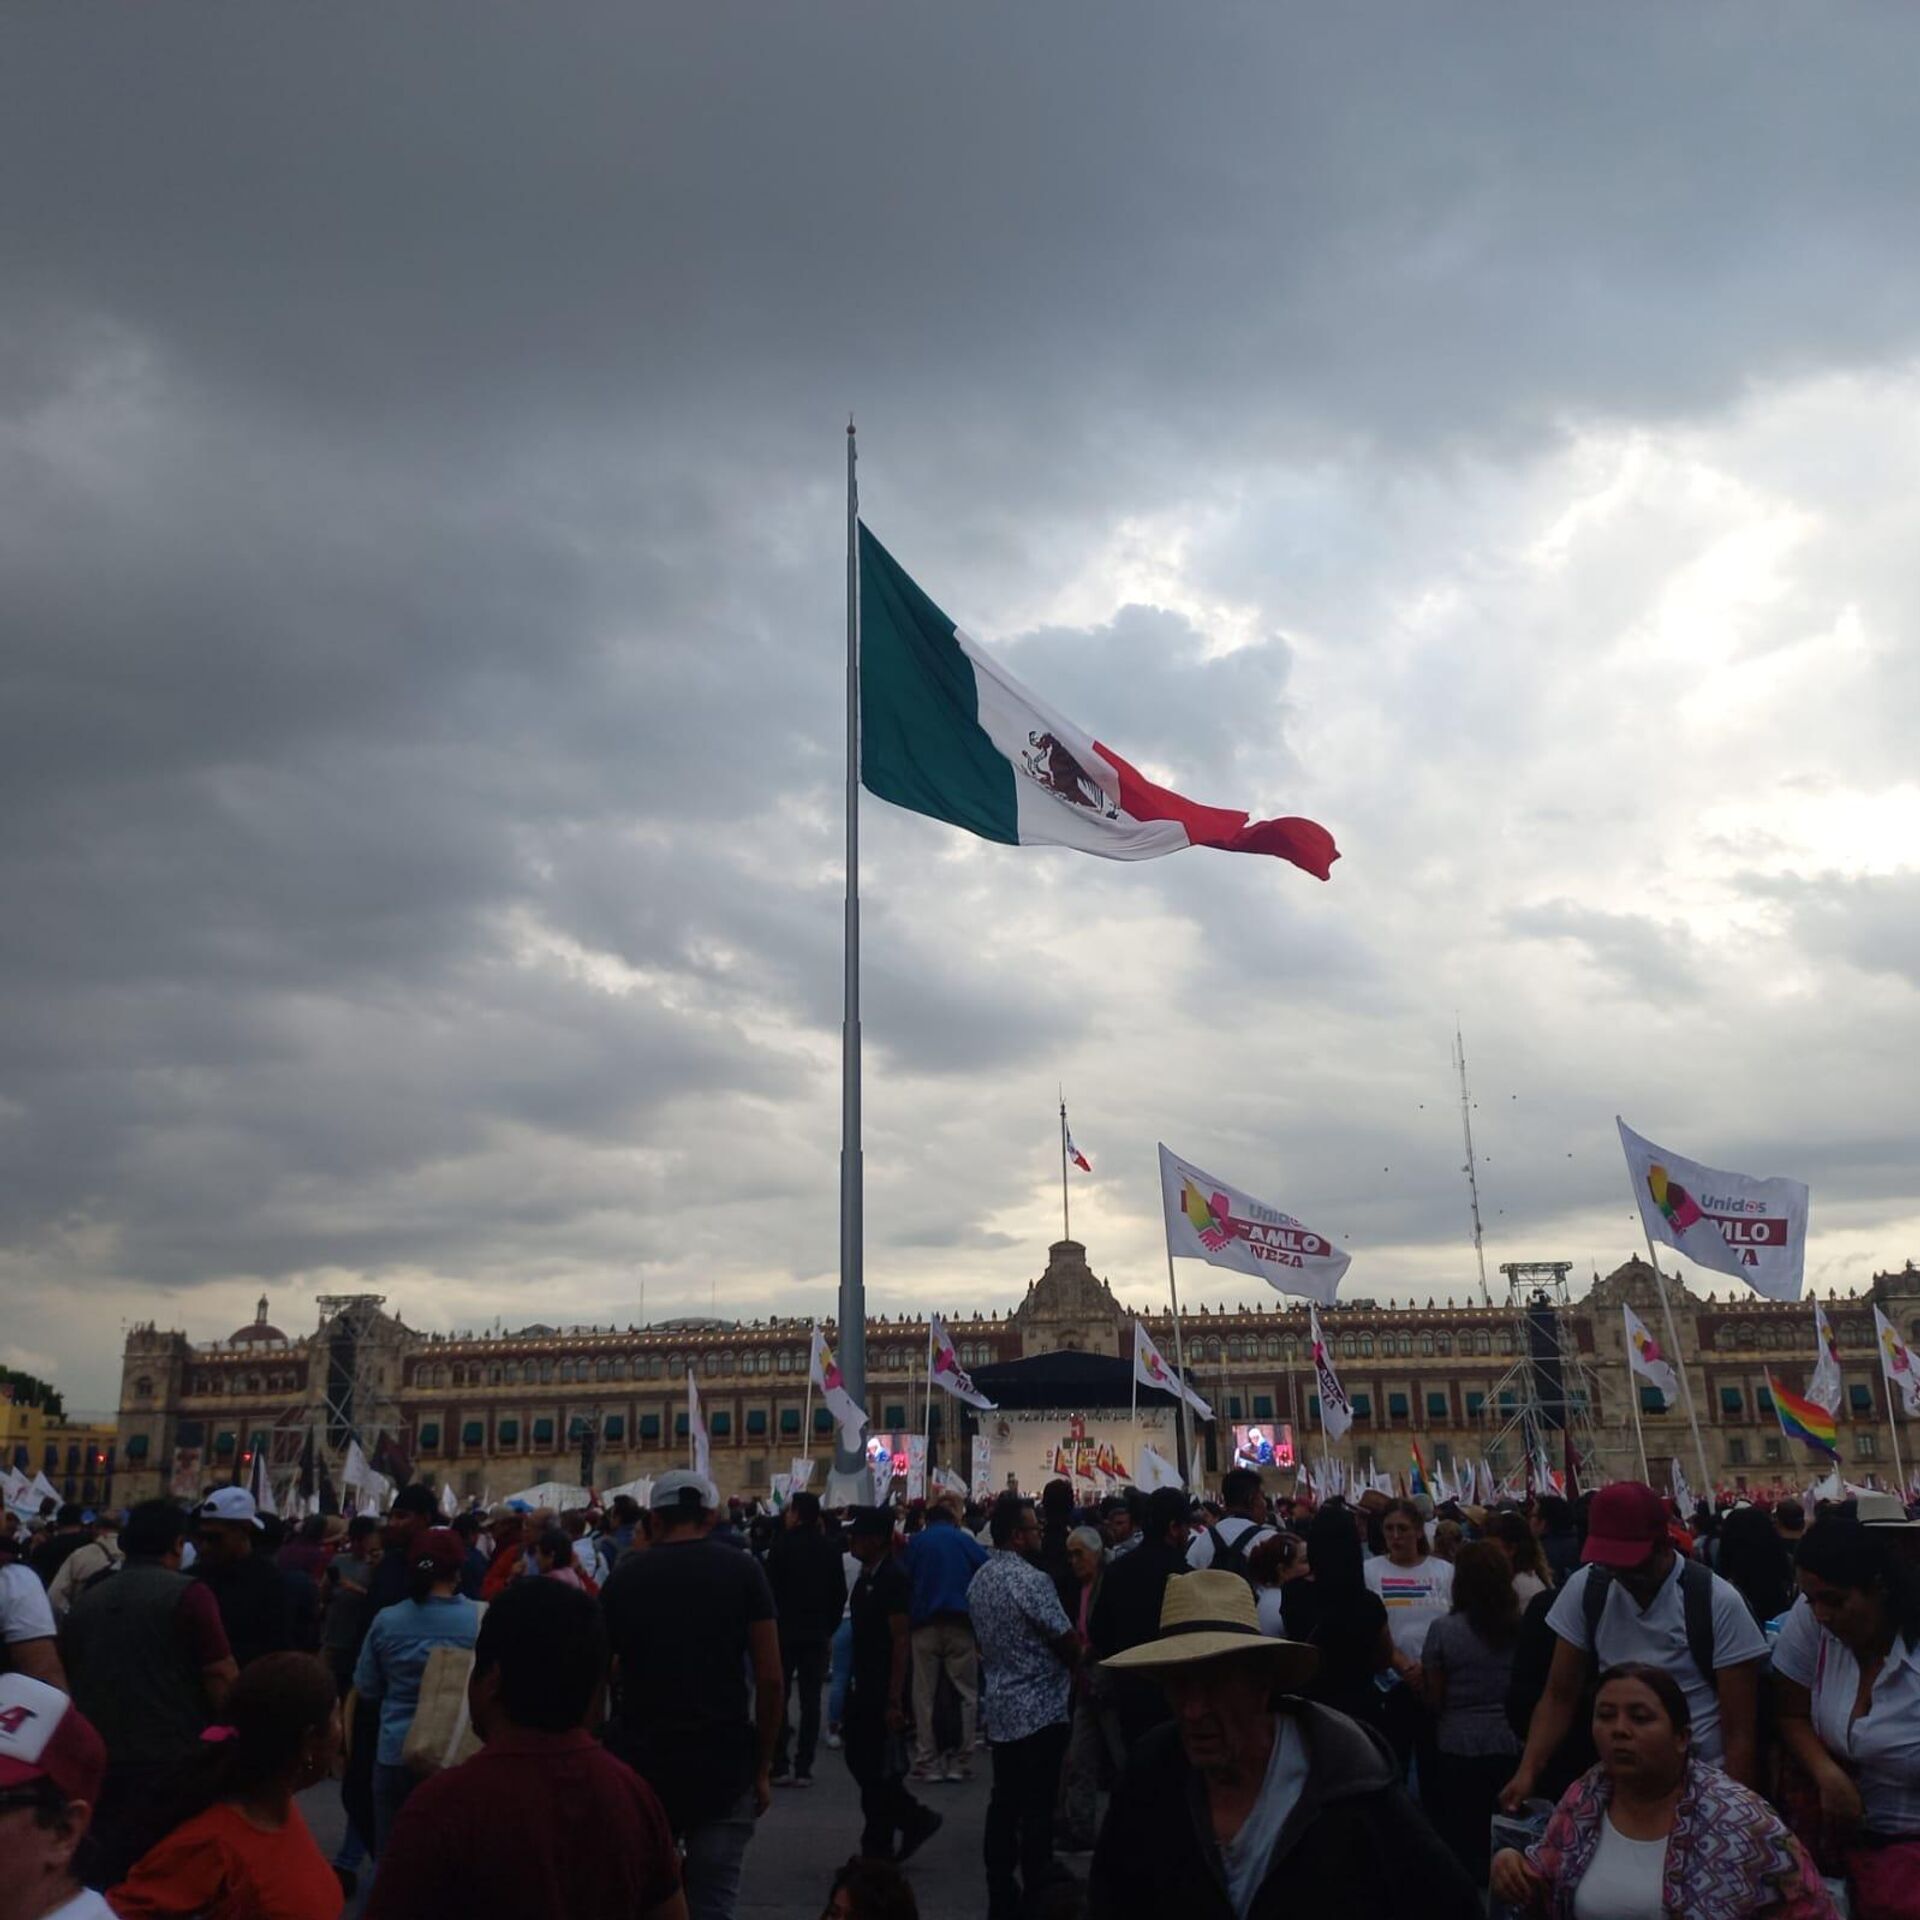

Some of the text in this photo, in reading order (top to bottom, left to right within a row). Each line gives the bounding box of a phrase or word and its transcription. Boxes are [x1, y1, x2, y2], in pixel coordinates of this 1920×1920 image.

[1248, 1225, 1320, 1253] AMLO
[1711, 1219, 1770, 1242] MLO
[1249, 1244, 1304, 1268] NEZA
